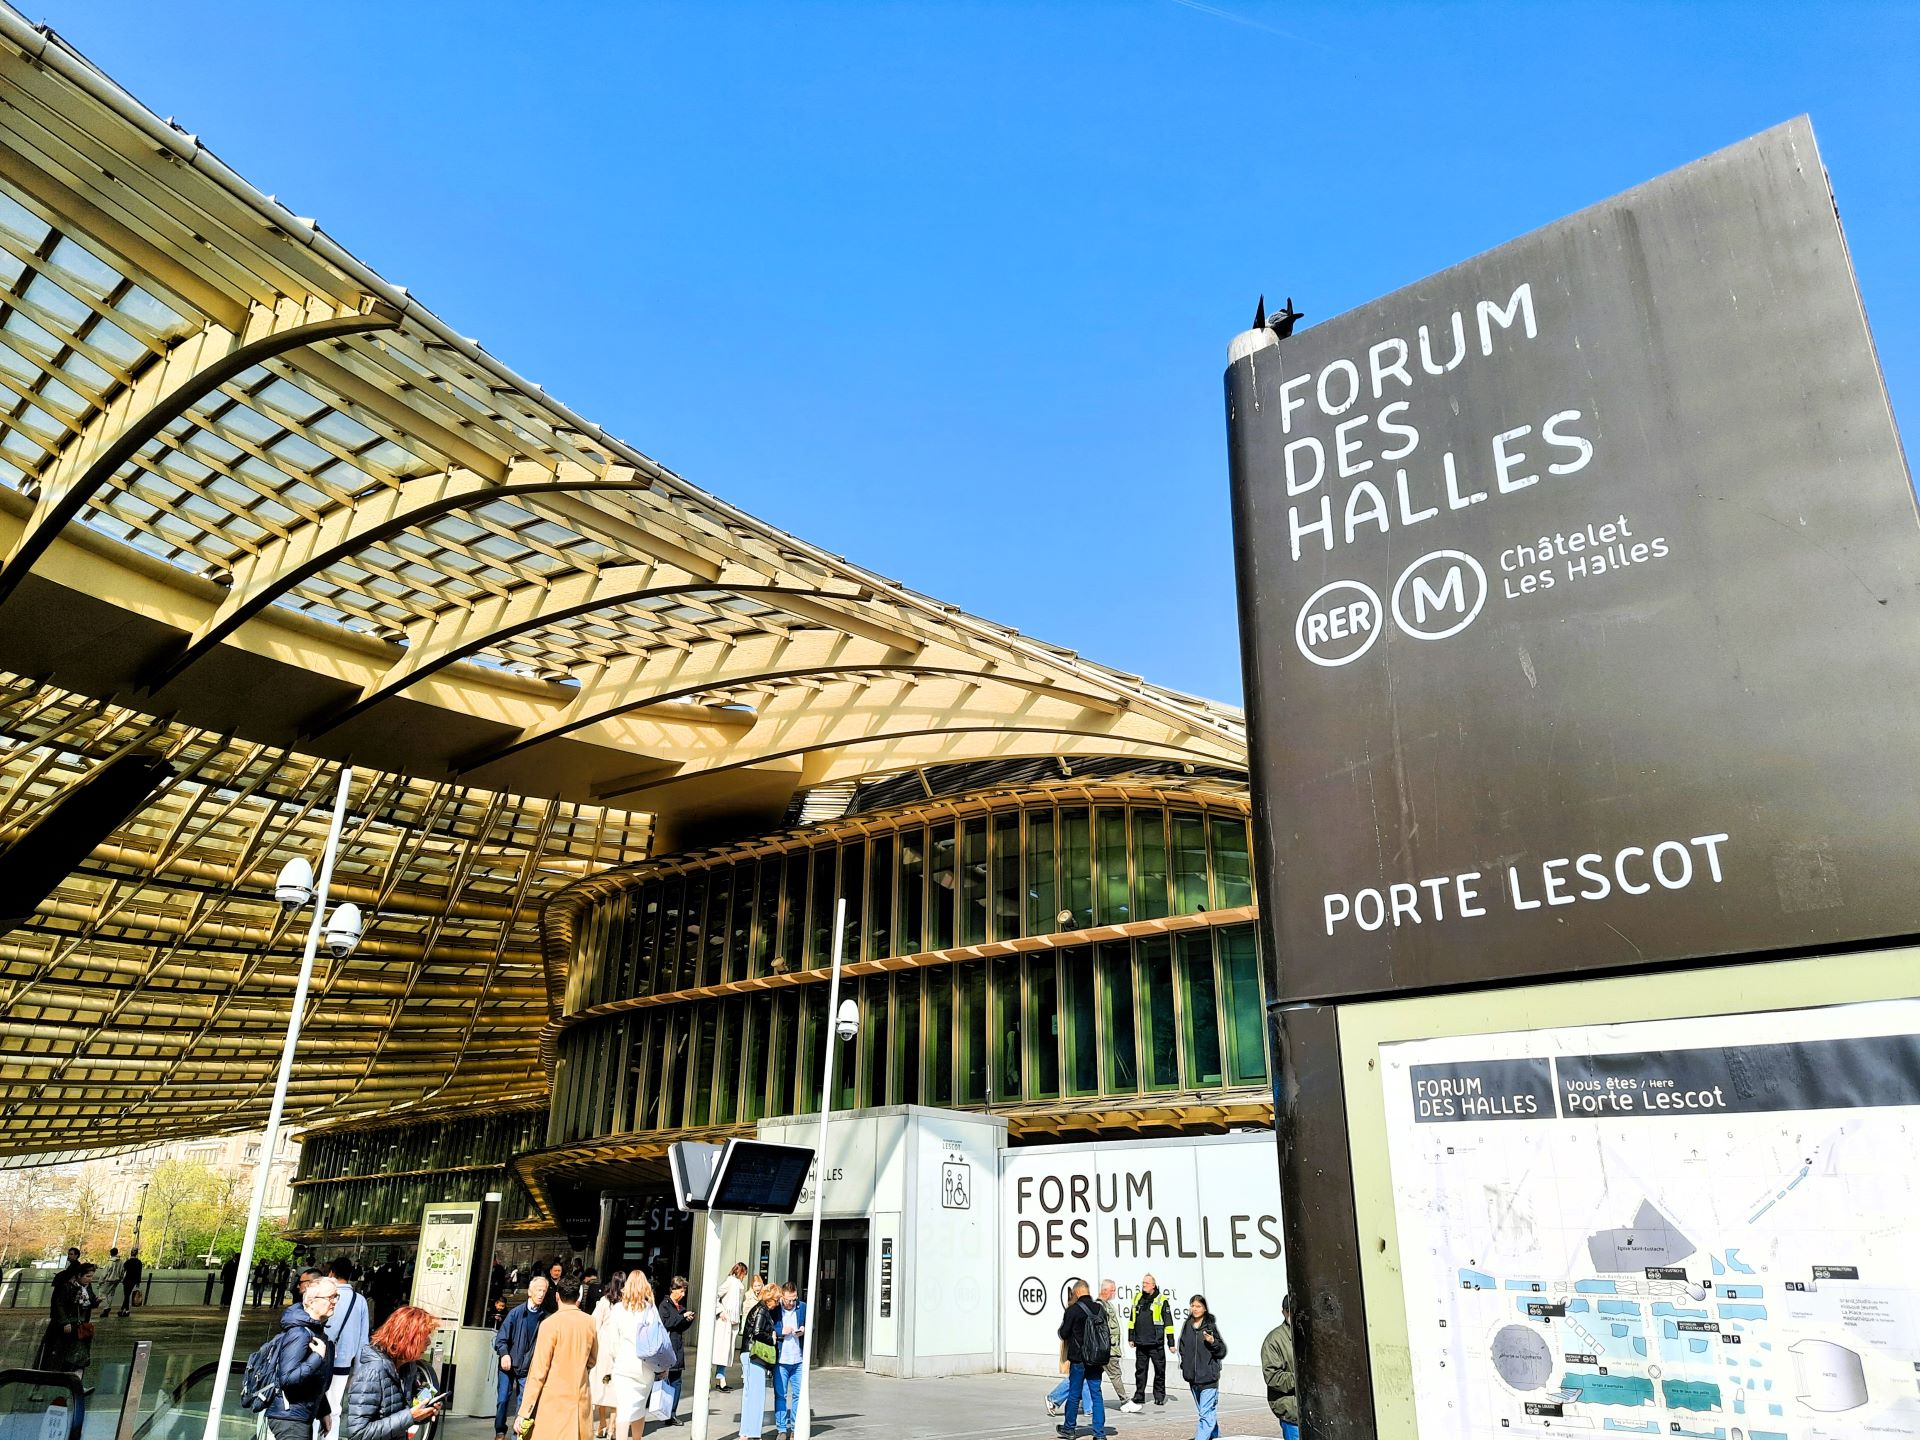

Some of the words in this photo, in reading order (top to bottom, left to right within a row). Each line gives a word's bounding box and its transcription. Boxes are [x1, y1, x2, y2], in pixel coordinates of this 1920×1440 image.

[1279, 282, 1538, 434] FORUM
[1283, 400, 1420, 497] DES
[1288, 409, 1594, 562] HALLES
[1499, 514, 1633, 572] Châtelet
[1503, 569, 1555, 599] Les
[1567, 537, 1669, 582] Halles
[1412, 565, 1466, 624] M
[1307, 601, 1371, 646] RER
[1323, 872, 1487, 936] PORTE
[1509, 833, 1729, 910] LESCOT
[1416, 1077, 1482, 1098] FORUM
[1419, 1099, 1455, 1117] DES
[1461, 1094, 1538, 1115] HALLES
[1566, 1079, 1602, 1091] Vous
[1605, 1077, 1638, 1090] êtes
[1649, 1079, 1675, 1088] Here
[1567, 1090, 1633, 1112] Porte
[1642, 1085, 1727, 1110] Lescot
[1017, 1170, 1153, 1215] FORUM
[1017, 1218, 1091, 1259] DES
[1113, 1214, 1282, 1260] HALLES
[1022, 1288, 1044, 1303] RER
